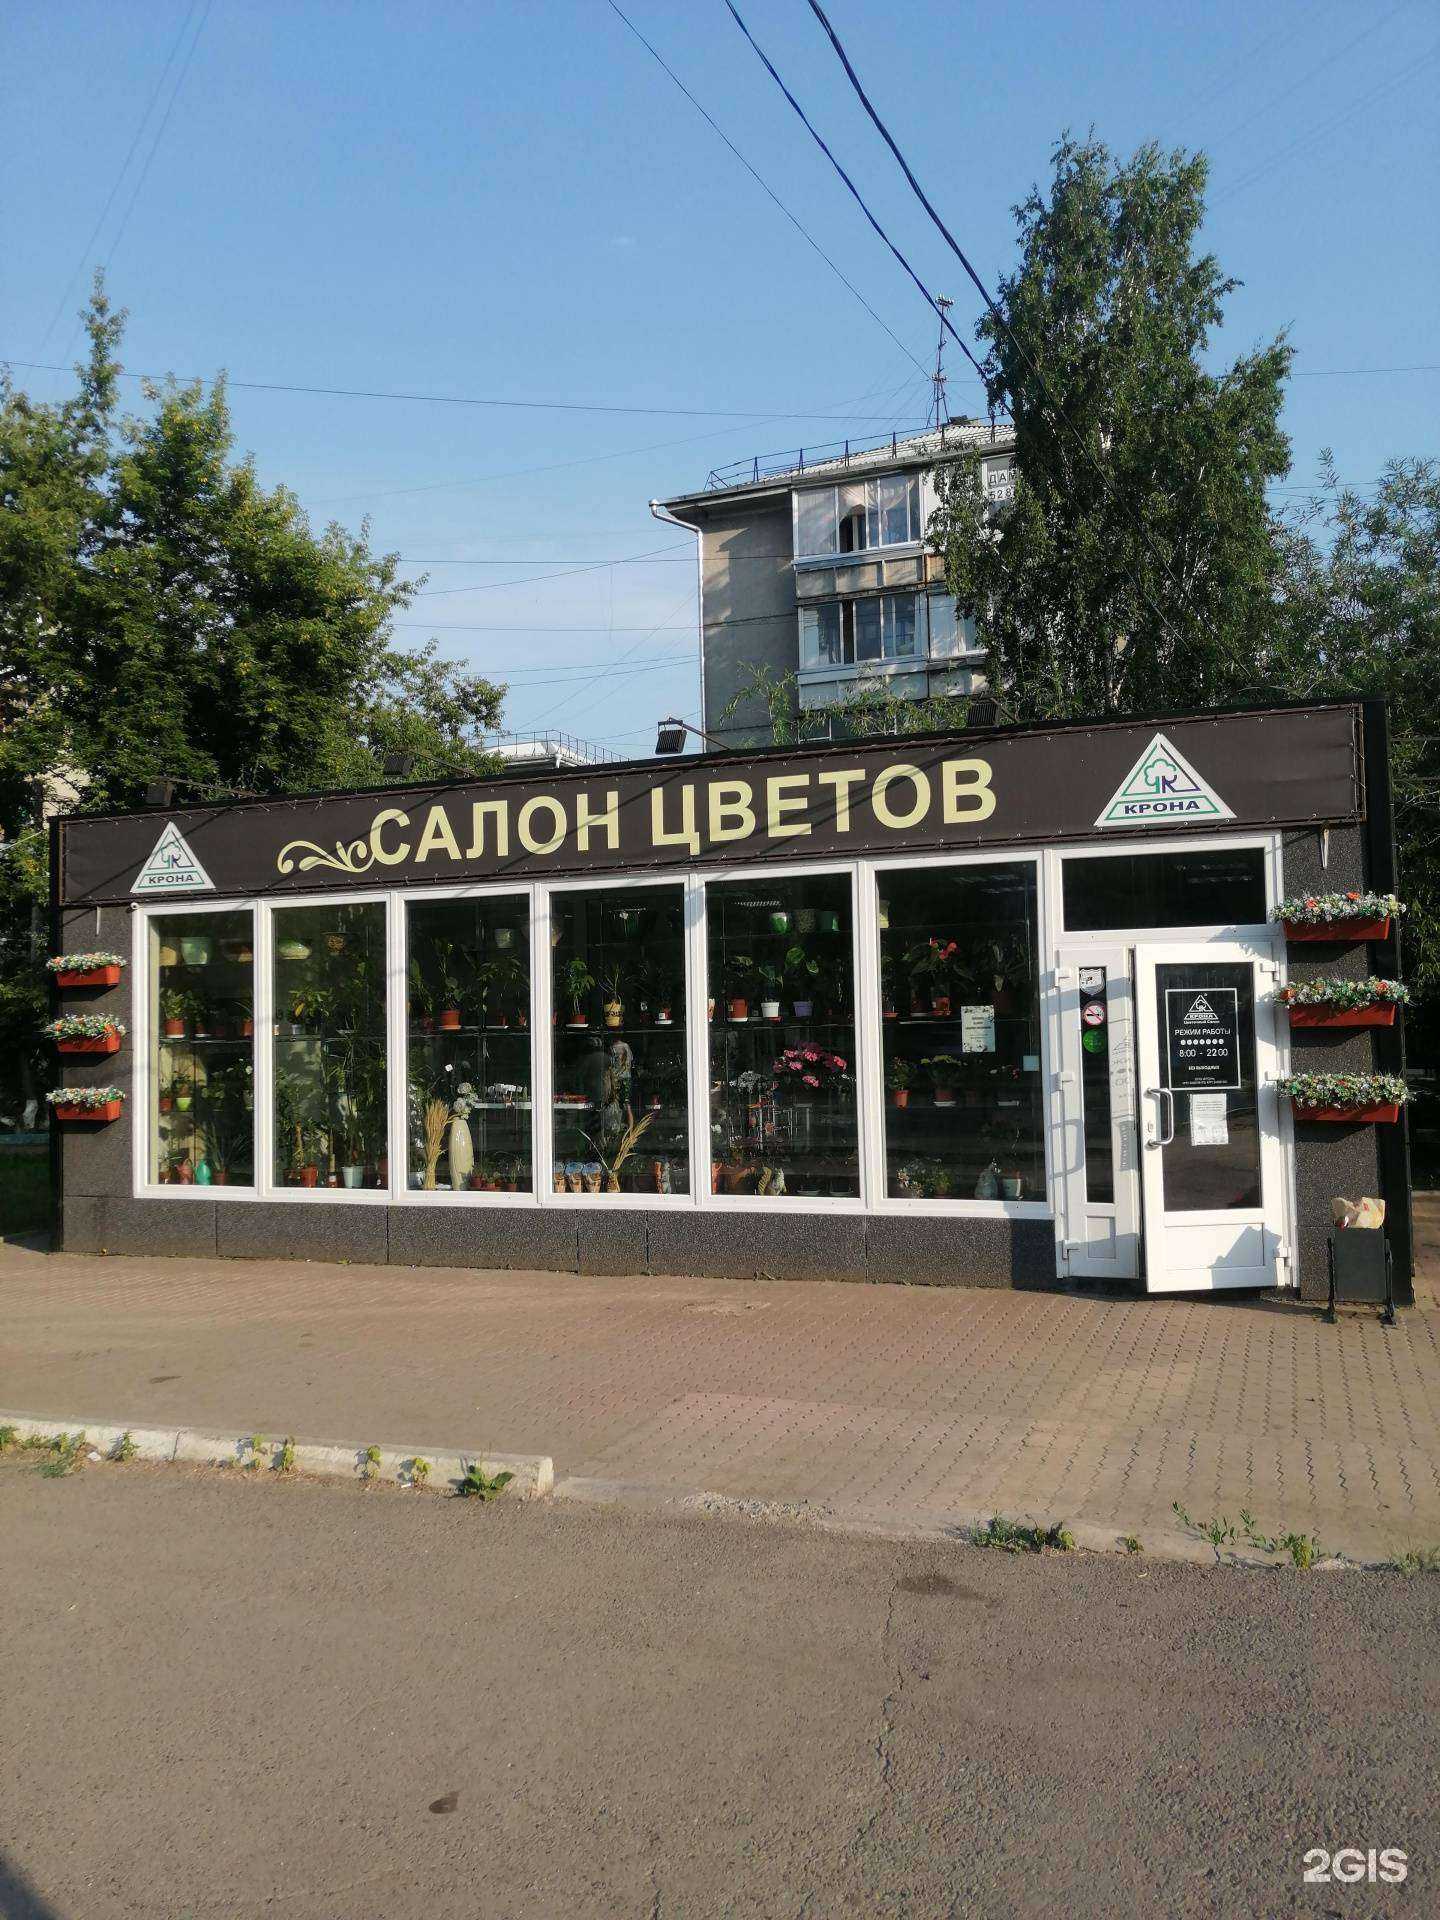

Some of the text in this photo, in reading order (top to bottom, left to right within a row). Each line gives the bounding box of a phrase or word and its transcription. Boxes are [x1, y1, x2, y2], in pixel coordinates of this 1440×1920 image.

[369, 757, 997, 866] САЛОН ЦВЕТОВ
[1123, 800, 1201, 815] КРОНА
[148, 874, 195, 885] КРОНА
